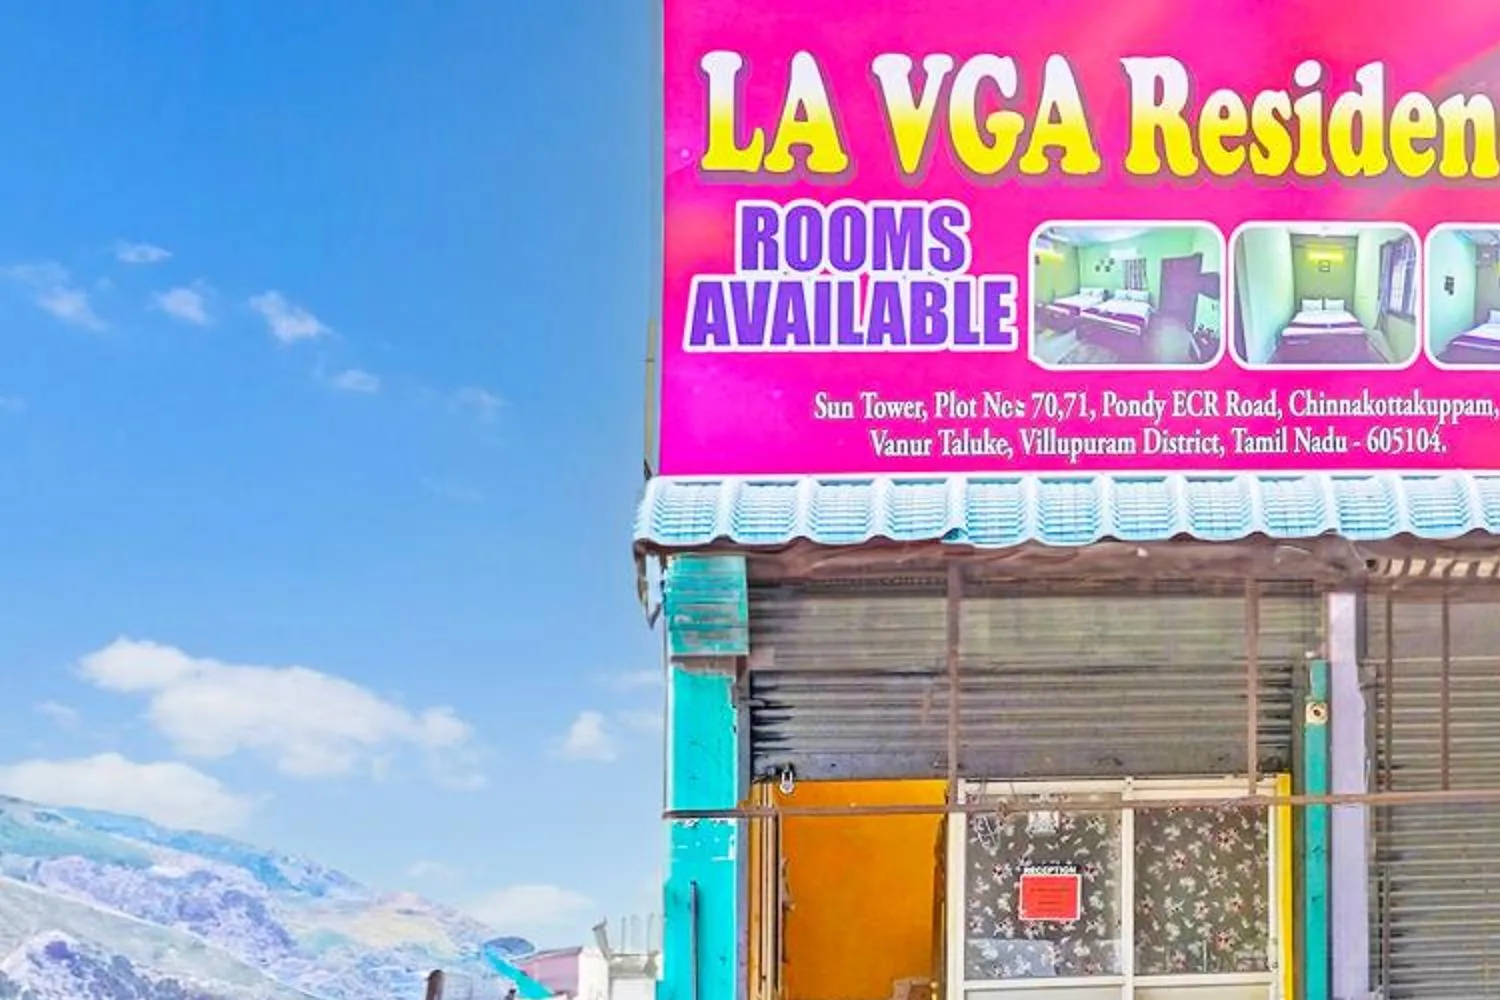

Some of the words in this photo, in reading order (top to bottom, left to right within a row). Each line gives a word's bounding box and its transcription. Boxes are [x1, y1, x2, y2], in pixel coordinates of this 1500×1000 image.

[700, 50, 849, 174] LA
[871, 52, 1101, 175] VGA
[739, 205, 968, 273] ROOMS
[687, 279, 1015, 348] AVAILABLE
[815, 391, 854, 419] Sun
[861, 391, 928, 422] Tower,
[935, 390, 977, 419] Plot
[1032, 391, 1097, 422] 70,71,
[1103, 390, 1167, 425] Pondy
[1172, 390, 1220, 418] ECR
[1226, 389, 1283, 420] Road,
[1289, 388, 1500, 425] Chinnakottakuppam,
[869, 429, 933, 457] Vanur
[938, 427, 1014, 458] Taluke,
[1020, 427, 1137, 464] Villupuram
[1143, 427, 1225, 458] District,
[1231, 426, 1288, 454] Tamil
[1294, 426, 1348, 453] Nadu
[1367, 425, 1447, 454] 605104.
